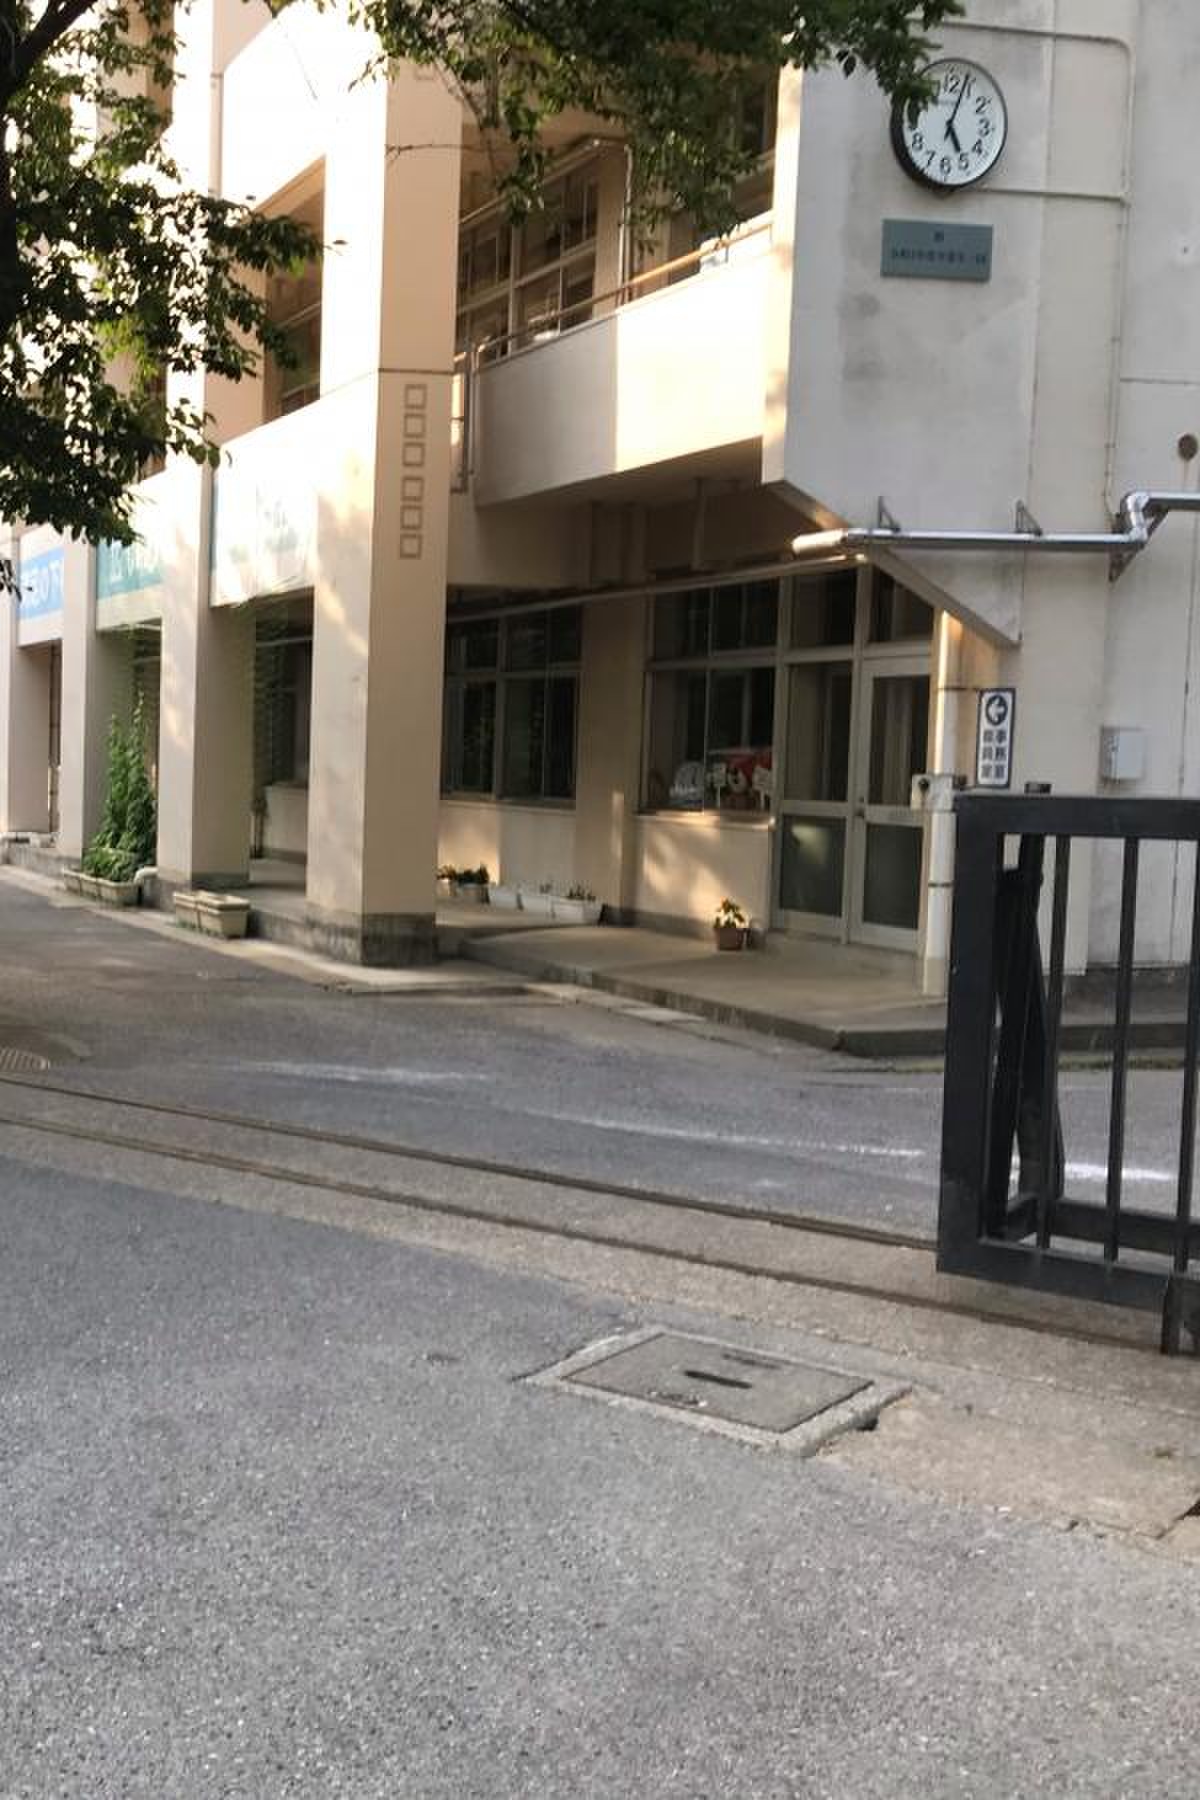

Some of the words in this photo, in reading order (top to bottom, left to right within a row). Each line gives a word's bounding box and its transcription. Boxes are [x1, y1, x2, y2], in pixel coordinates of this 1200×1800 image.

[976, 96, 987, 114] 2
[979, 118, 990, 137] 3
[911, 132, 923, 151] 8
[972, 138, 982, 155] 4
[925, 150, 936, 167] 7
[940, 157, 951, 175] 6
[958, 152, 969, 170] 5
